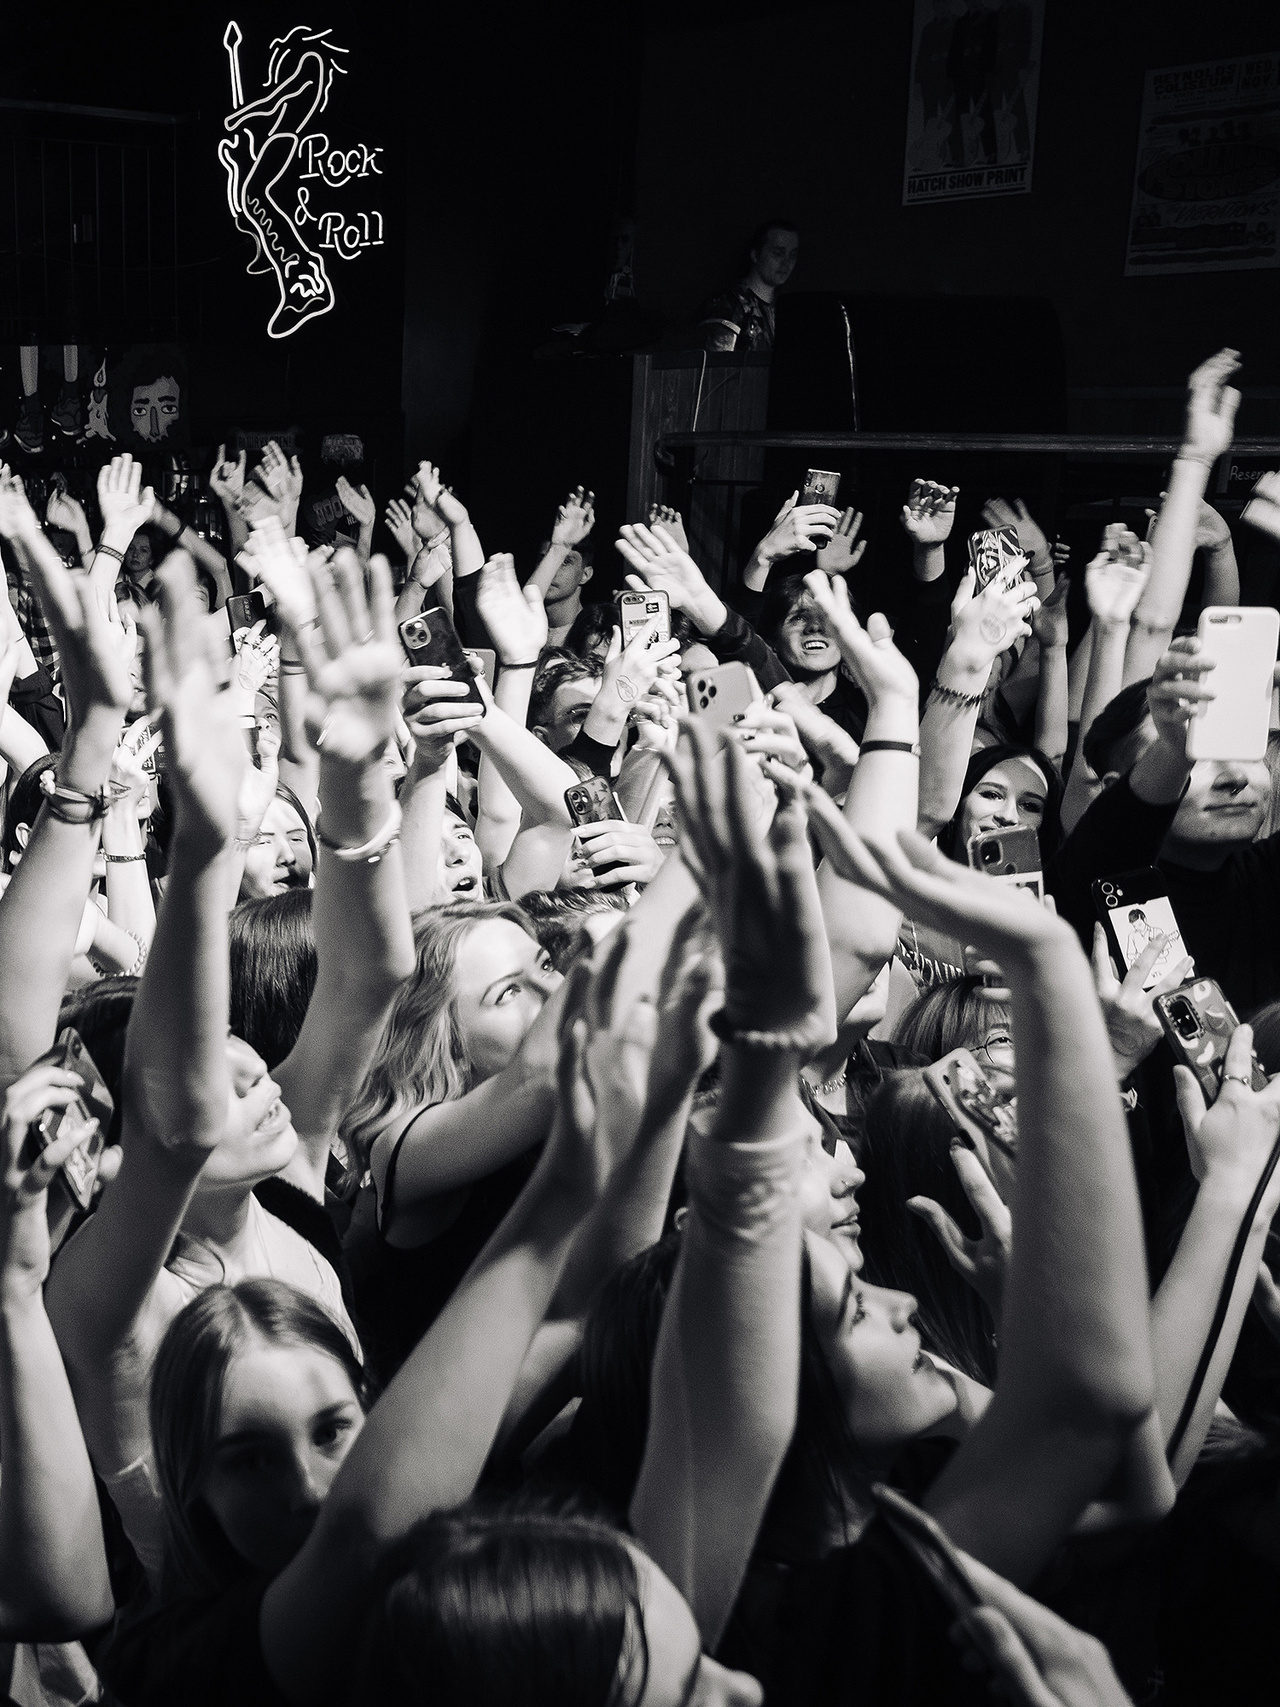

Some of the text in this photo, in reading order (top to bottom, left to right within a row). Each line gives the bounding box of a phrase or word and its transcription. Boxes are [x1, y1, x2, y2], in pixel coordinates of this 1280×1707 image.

[1153, 63, 1238, 86] REYNOLDS
[1245, 59, 1275, 75] WED.
[1154, 75, 1235, 95] COLISEUM
[1241, 73, 1273, 90] NOV.
[298, 133, 384, 188] Rock
[907, 176, 947, 194] HATCH
[948, 171, 985, 190] SHOW
[986, 167, 1028, 185] PRINT
[294, 186, 318, 226] &
[317, 210, 385, 260] Roll
[1230, 465, 1265, 481] Reser
[312, 494, 349, 527] BOO
